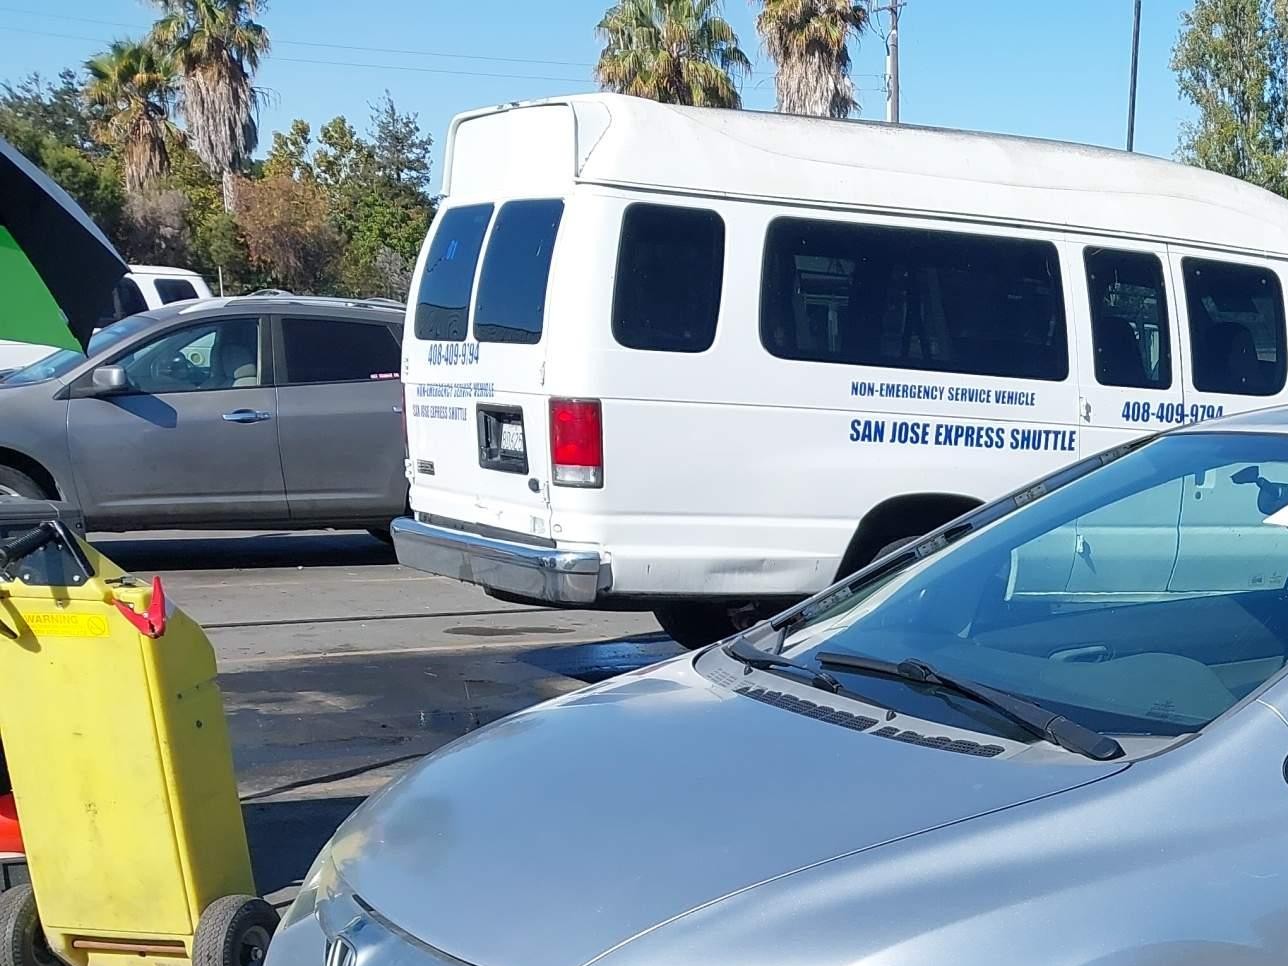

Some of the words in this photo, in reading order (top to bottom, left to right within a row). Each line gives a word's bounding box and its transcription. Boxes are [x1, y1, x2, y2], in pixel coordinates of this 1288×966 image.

[851, 381, 945, 401] NON-EMERGENCY
[948, 386, 991, 404] SERVICE
[995, 389, 1036, 406] VEHICLE
[1121, 401, 1224, 424] 408-409-9794
[850, 418, 886, 442] SAN
[889, 421, 930, 444] JOSE
[934, 423, 1005, 449] EXPRESS
[1010, 428, 1077, 451] SHUTTLE
[25, 614, 80, 625] WARNING
